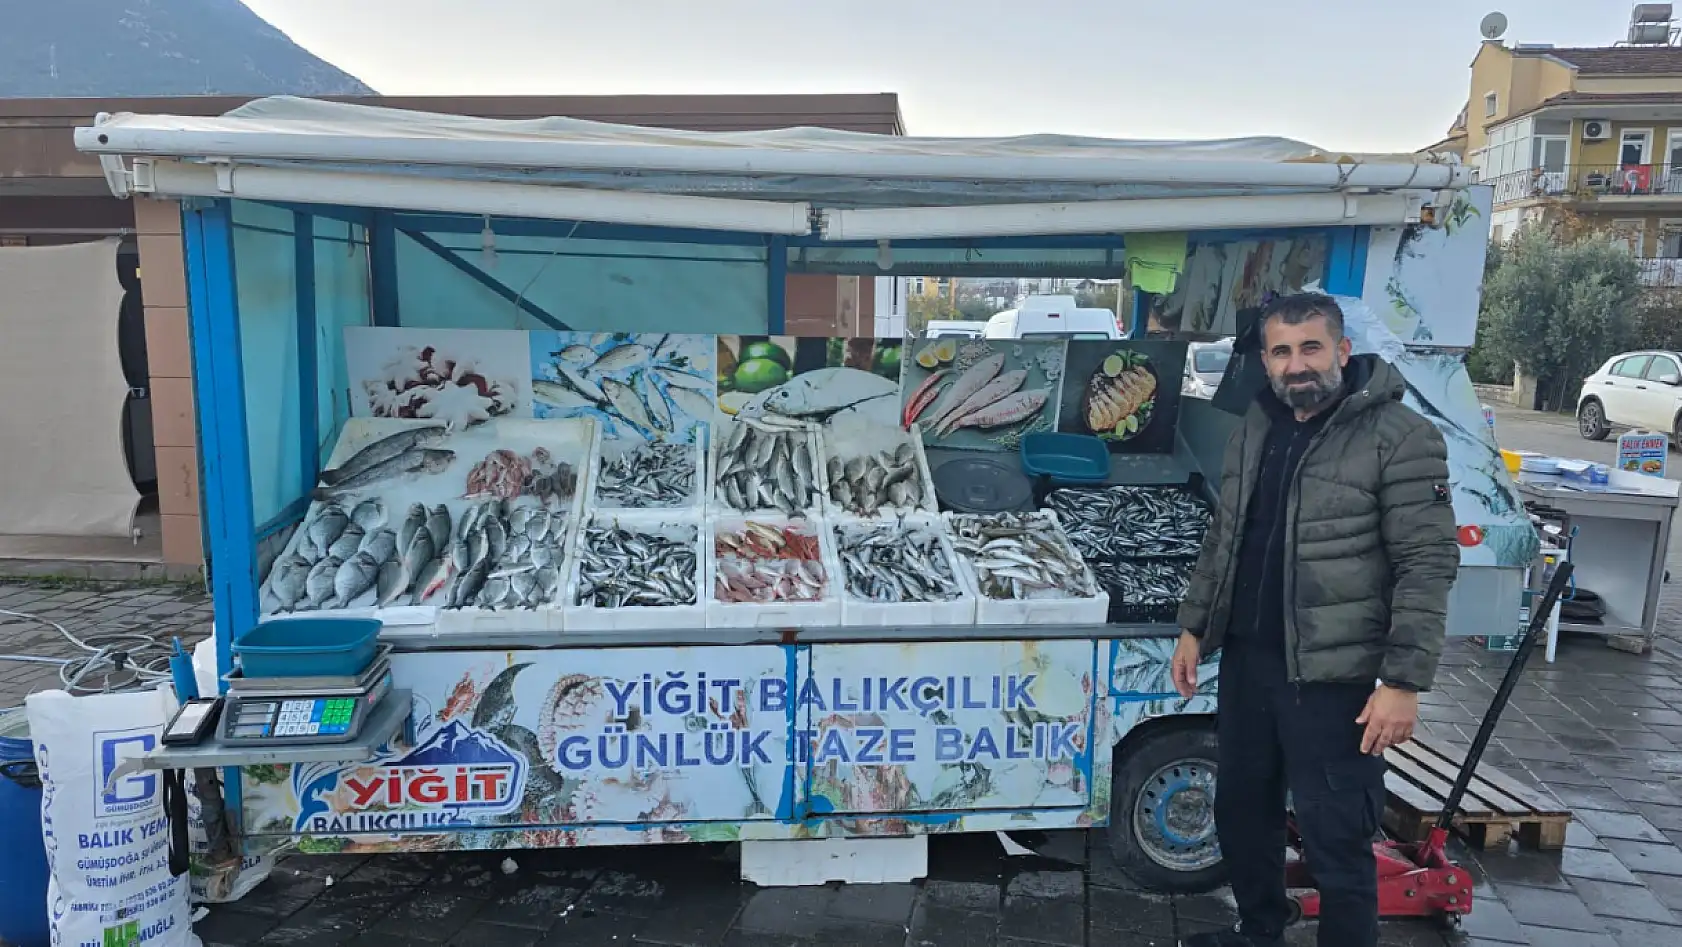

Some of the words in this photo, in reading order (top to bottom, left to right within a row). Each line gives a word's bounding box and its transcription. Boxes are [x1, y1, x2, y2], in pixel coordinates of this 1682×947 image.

[604, 671, 740, 716] YİĞİT
[759, 675, 1037, 717] BALIKÇILIK
[557, 722, 772, 769] GÜNLÜK
[796, 729, 916, 763] TAZE
[935, 724, 1079, 761] BALIK
[344, 767, 506, 805] YİĞİT
[78, 827, 134, 849] BALIK
[77, 852, 140, 871] GÜMÜŞDOĞA
[86, 874, 117, 888] ÜRETİM
[138, 914, 175, 943] MUĞLA
